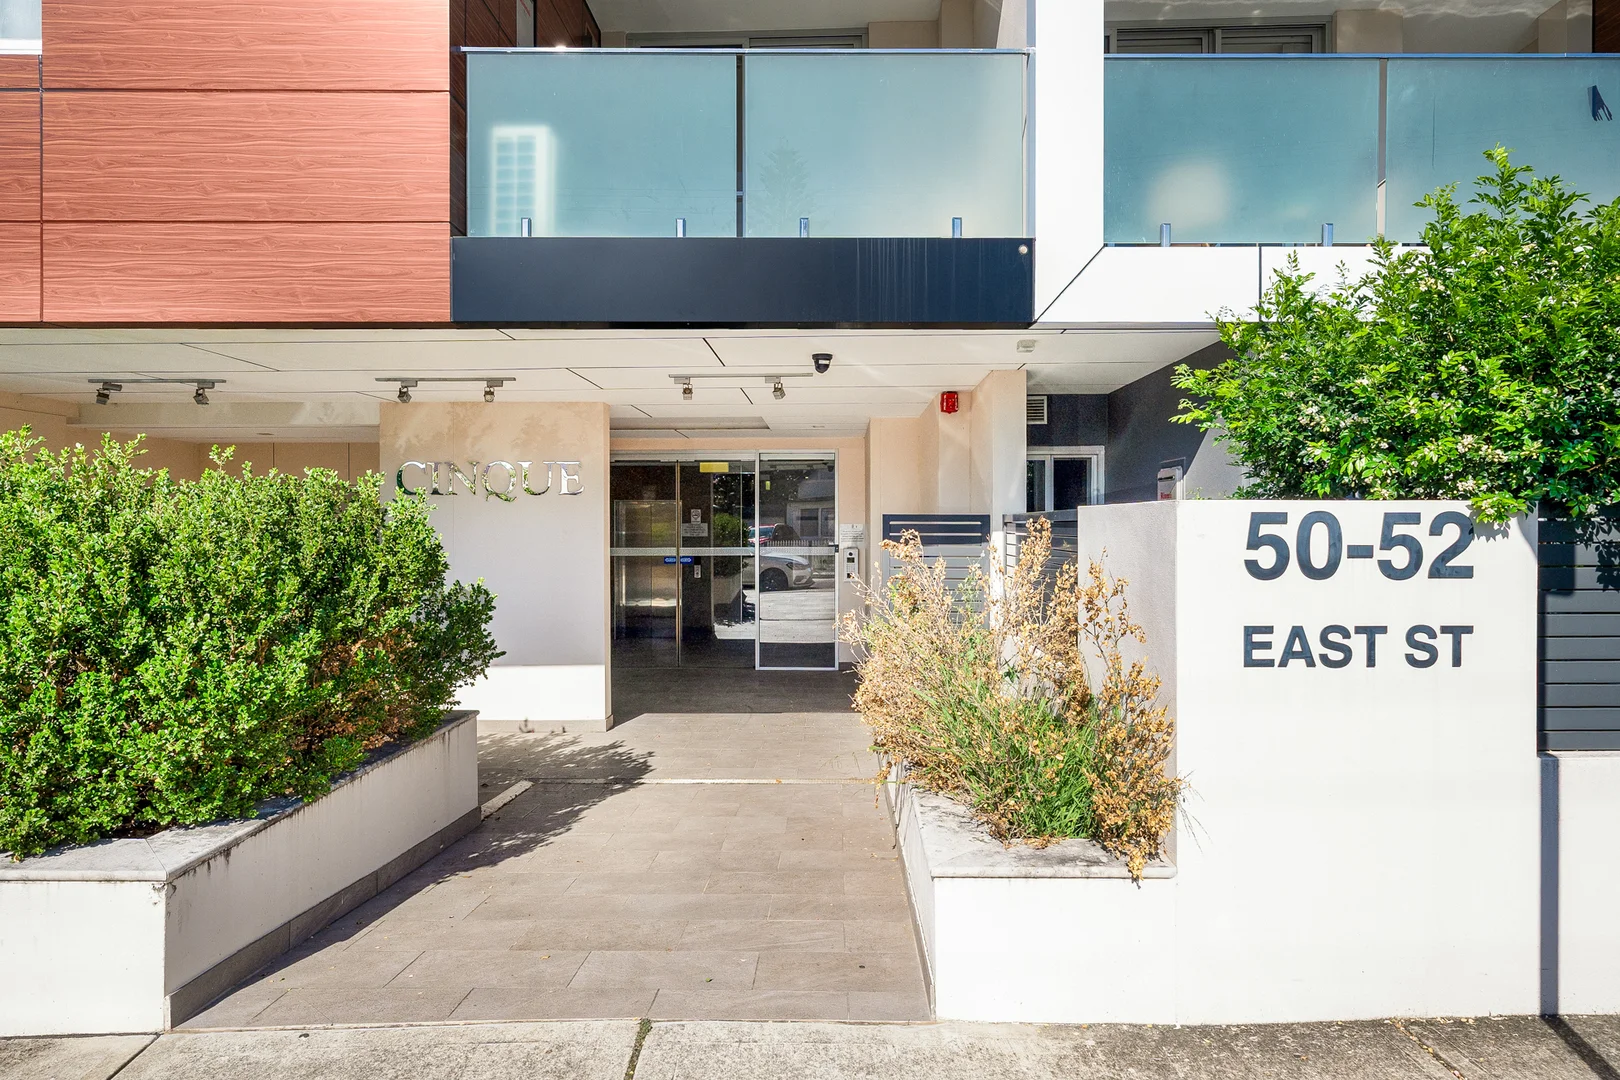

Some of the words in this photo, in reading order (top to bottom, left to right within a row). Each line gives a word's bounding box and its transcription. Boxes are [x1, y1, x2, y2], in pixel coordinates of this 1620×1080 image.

[396, 460, 585, 502] CINQUE
[1244, 510, 1474, 580] 50-52
[1243, 624, 1388, 669] EAST
[1404, 624, 1474, 669] ST
